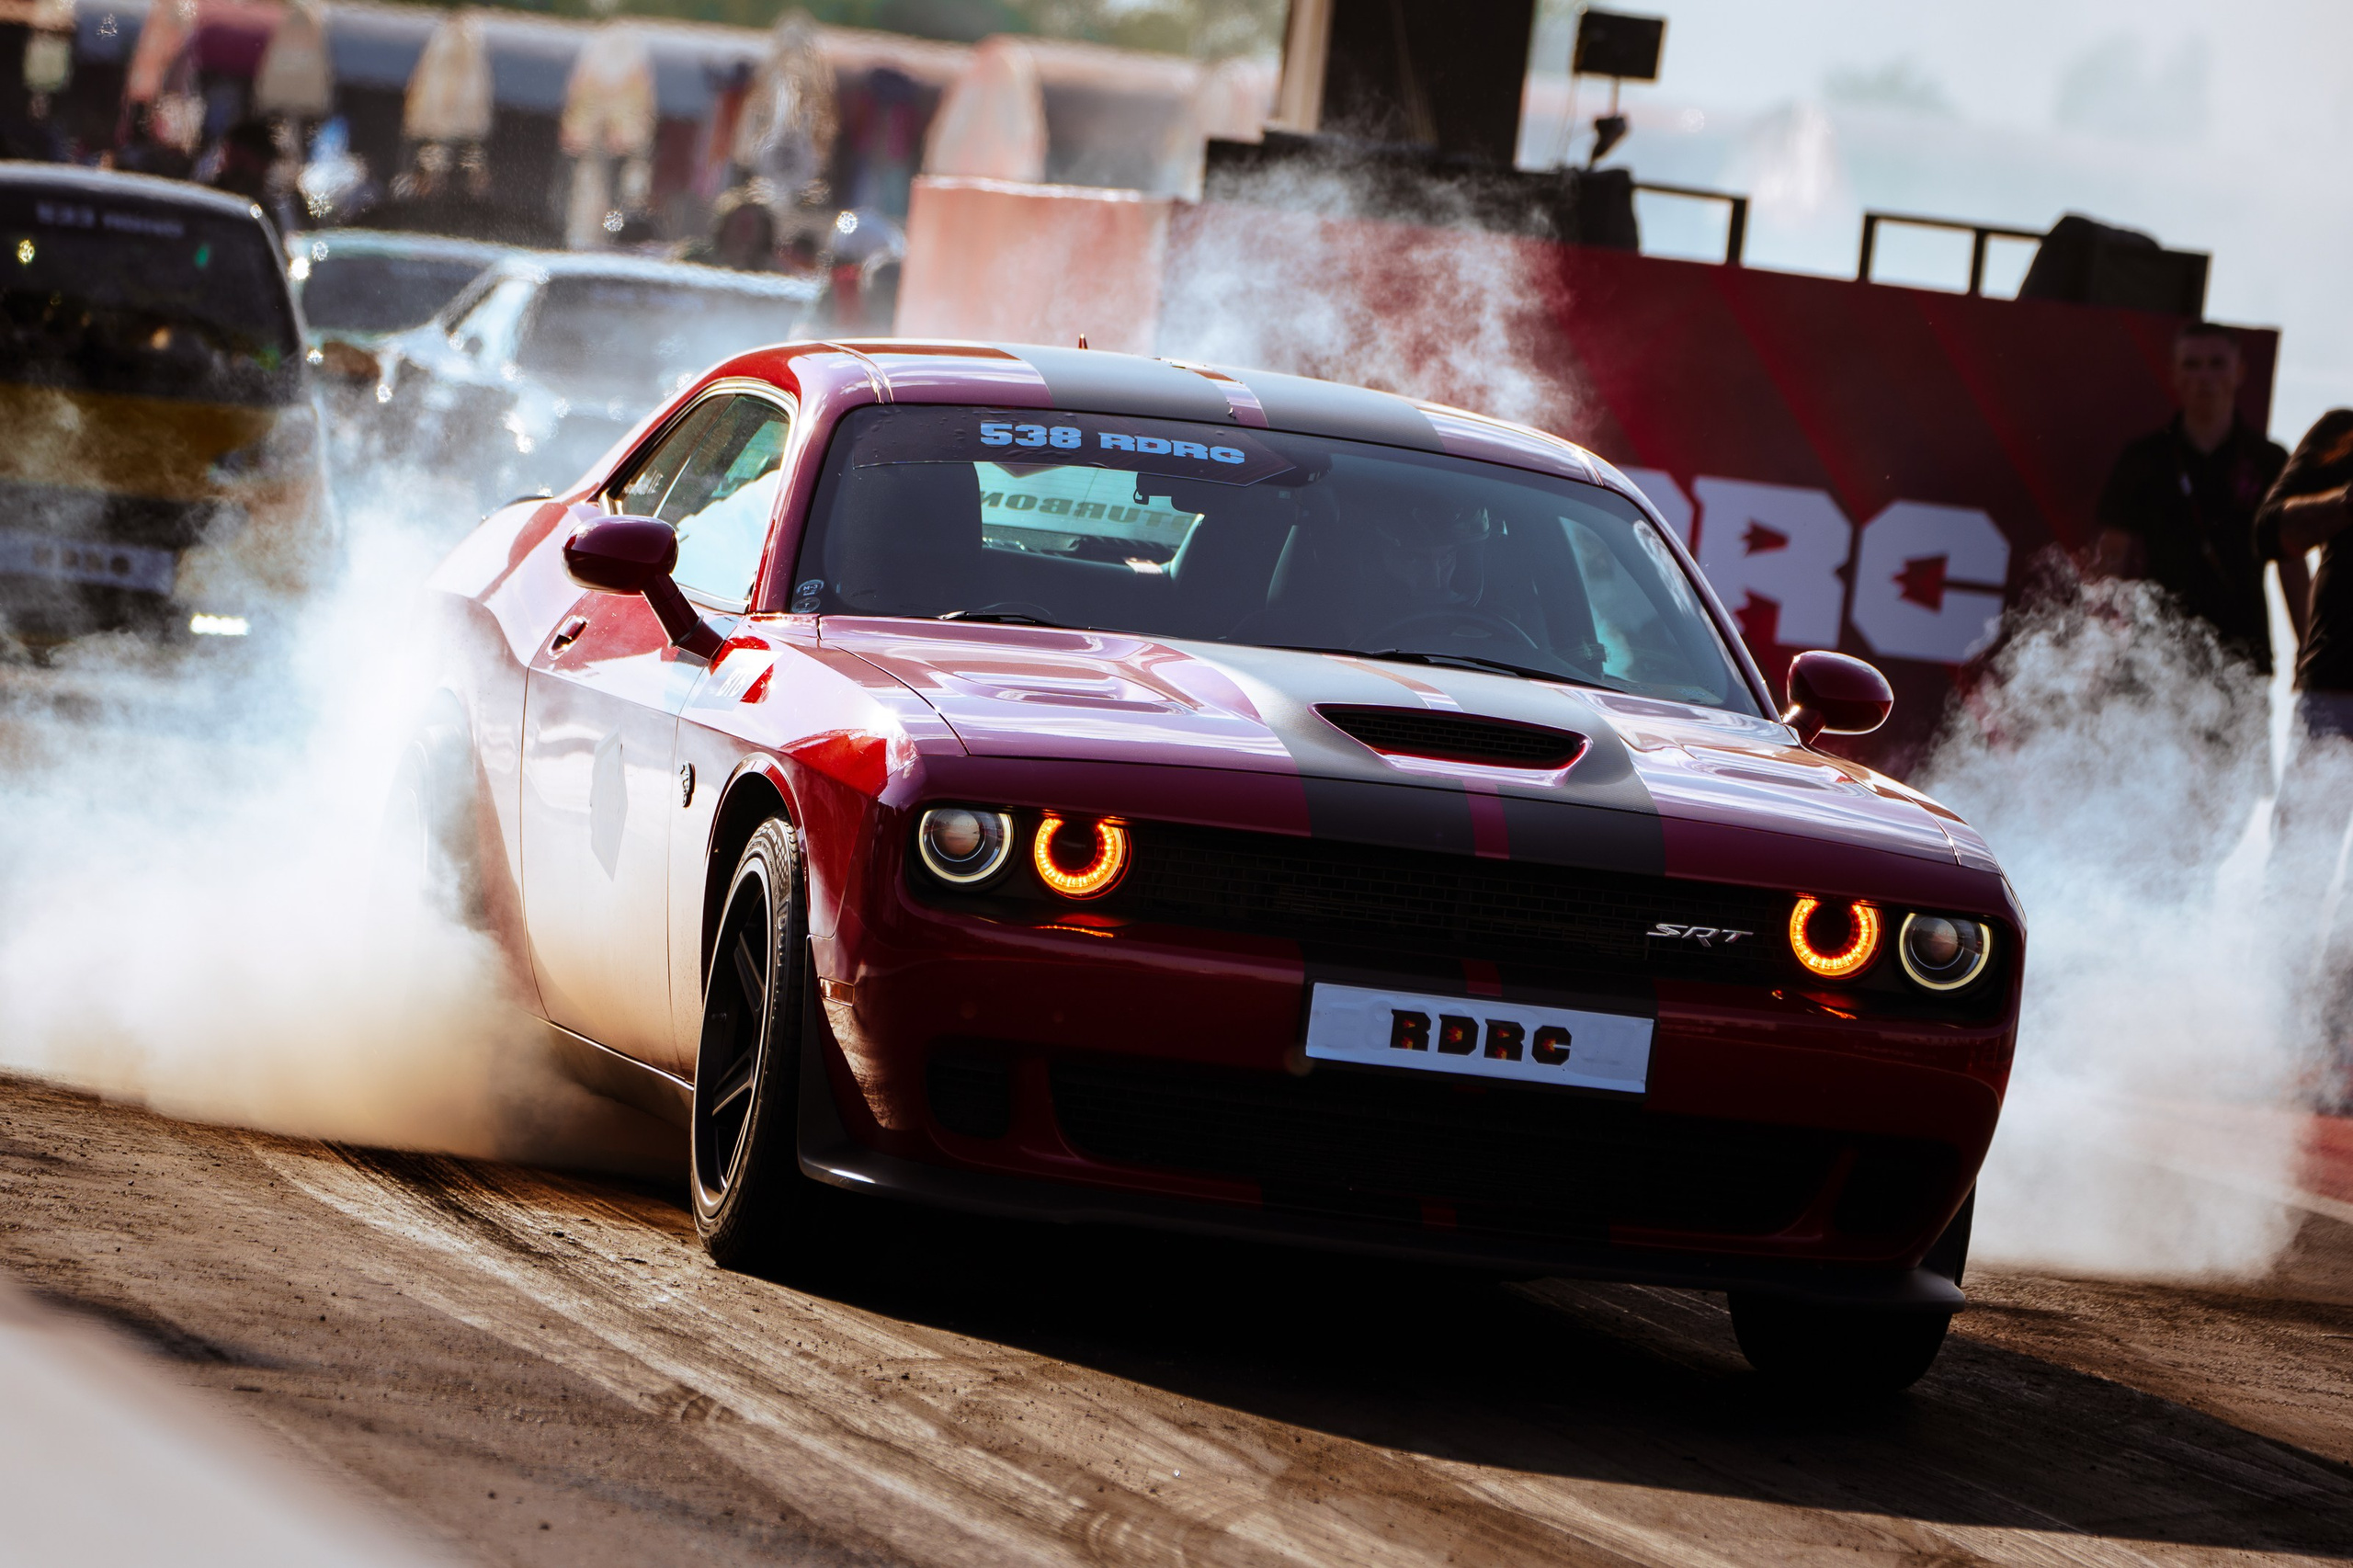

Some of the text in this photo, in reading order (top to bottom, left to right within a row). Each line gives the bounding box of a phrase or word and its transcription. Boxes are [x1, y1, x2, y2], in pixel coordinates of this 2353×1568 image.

[980, 422, 1245, 464] 538 RDRC
[1647, 923, 1753, 948] SRT
[1391, 1009, 1572, 1065] RDRC
